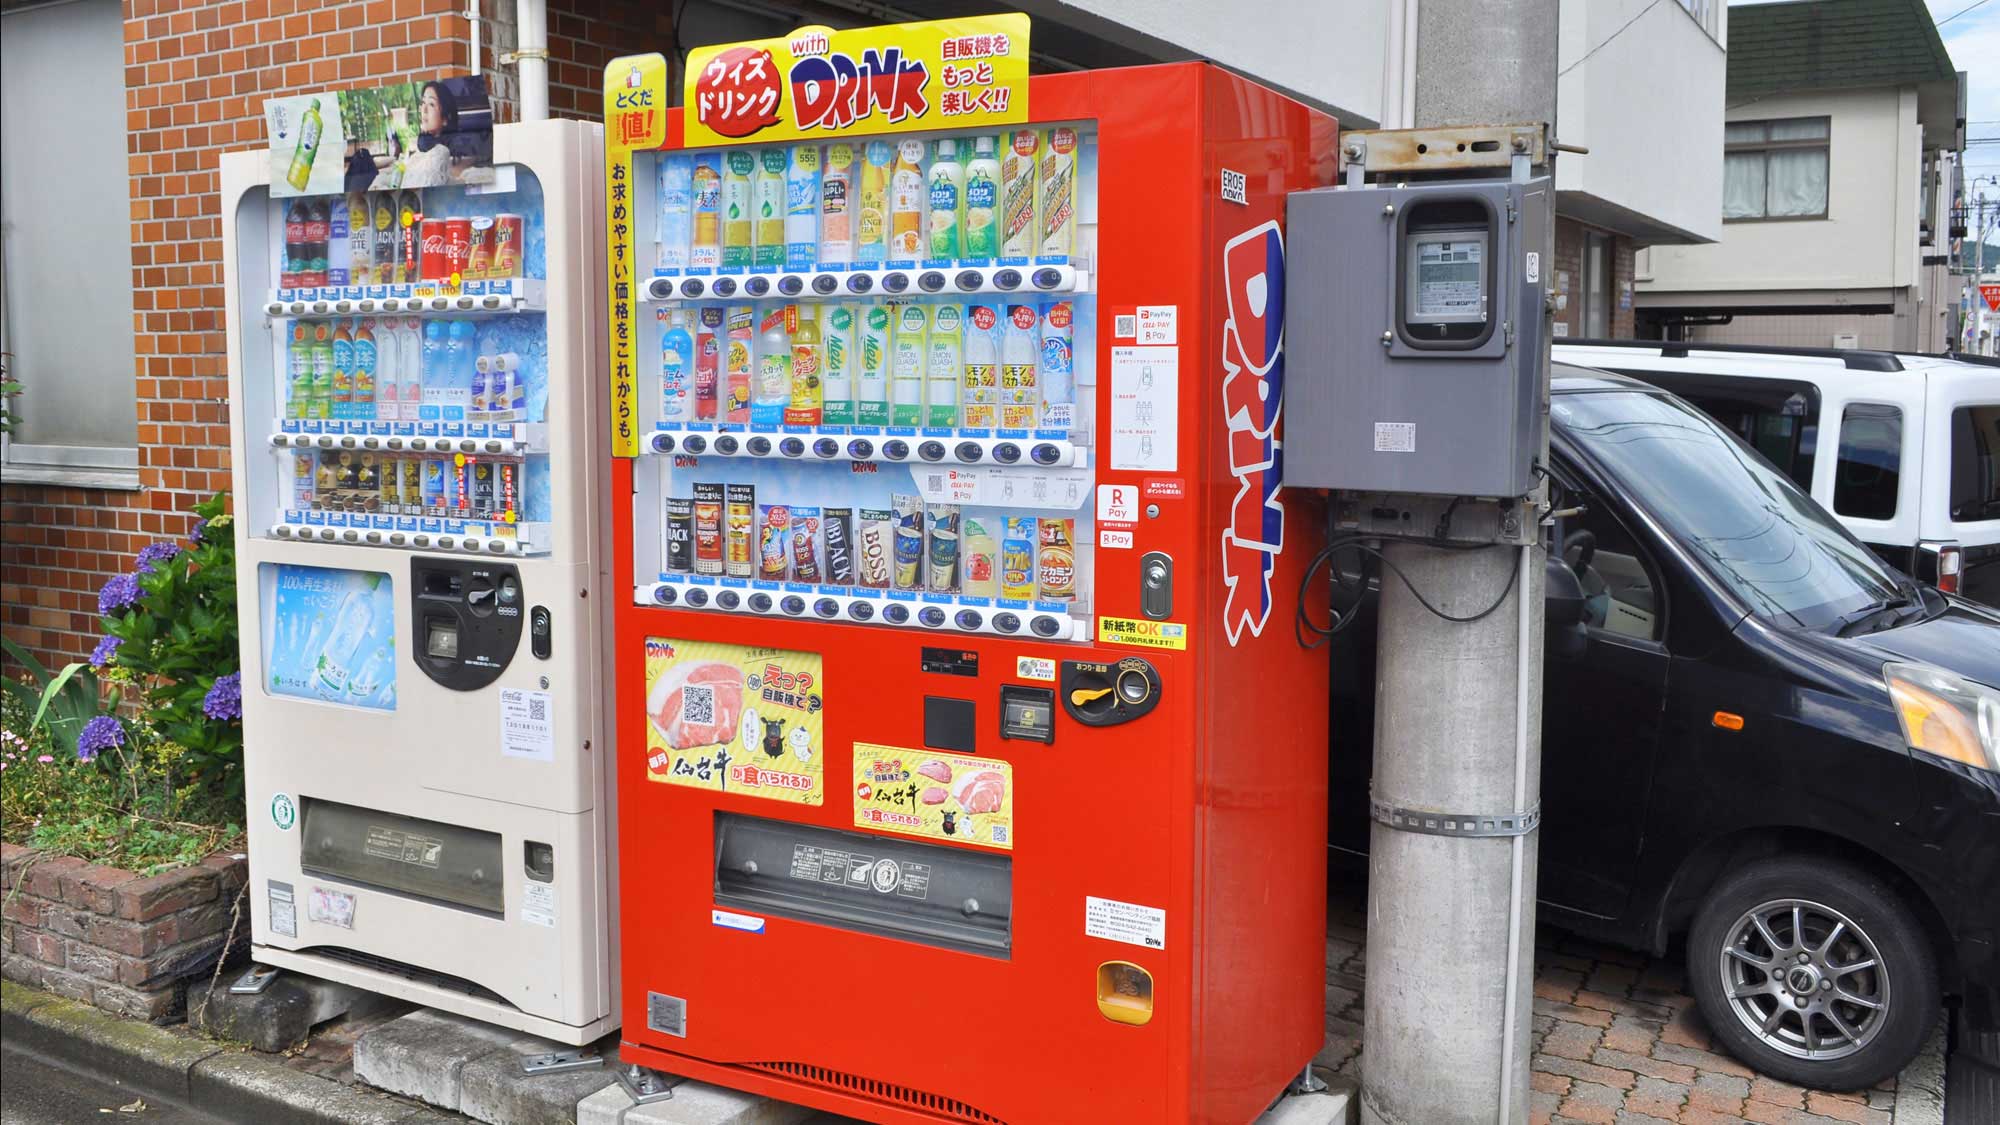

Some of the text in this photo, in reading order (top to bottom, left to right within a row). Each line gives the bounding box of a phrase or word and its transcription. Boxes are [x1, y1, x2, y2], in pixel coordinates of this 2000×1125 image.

[791, 33, 827, 56] with
[942, 34, 1008, 60] 自販機を
[707, 51, 771, 87] ウィズ
[943, 61, 993, 85] もっと
[616, 88, 653, 108] とくだ
[789, 48, 931, 131] DRINK
[699, 84, 778, 122] ドリンク
[799, 154, 816, 163] 555
[611, 162, 632, 448] お求めやすい価格をこれからも。
[1150, 310, 1172, 319] PayPay
[1153, 331, 1166, 340] Pay
[1157, 320, 1170, 329] PAY
[866, 334, 880, 370] Mets
[967, 366, 988, 377] レモン
[1004, 366, 1026, 377] レモン
[1222, 218, 1285, 647] DRINK
[957, 472, 977, 480] PayPay
[1112, 488, 1124, 505] R
[1108, 508, 1128, 519] Pay
[1111, 534, 1130, 545] Pay
[825, 524, 853, 581] BLACK
[865, 529, 888, 581] BOSS
[646, 642, 675, 659] DRINK
[763, 664, 814, 694] えっ?
[671, 747, 732, 792] 仙台牛
[732, 763, 814, 791] が食べられるか
[873, 759, 902, 775] えっ?
[873, 781, 921, 815] 仙台牛
